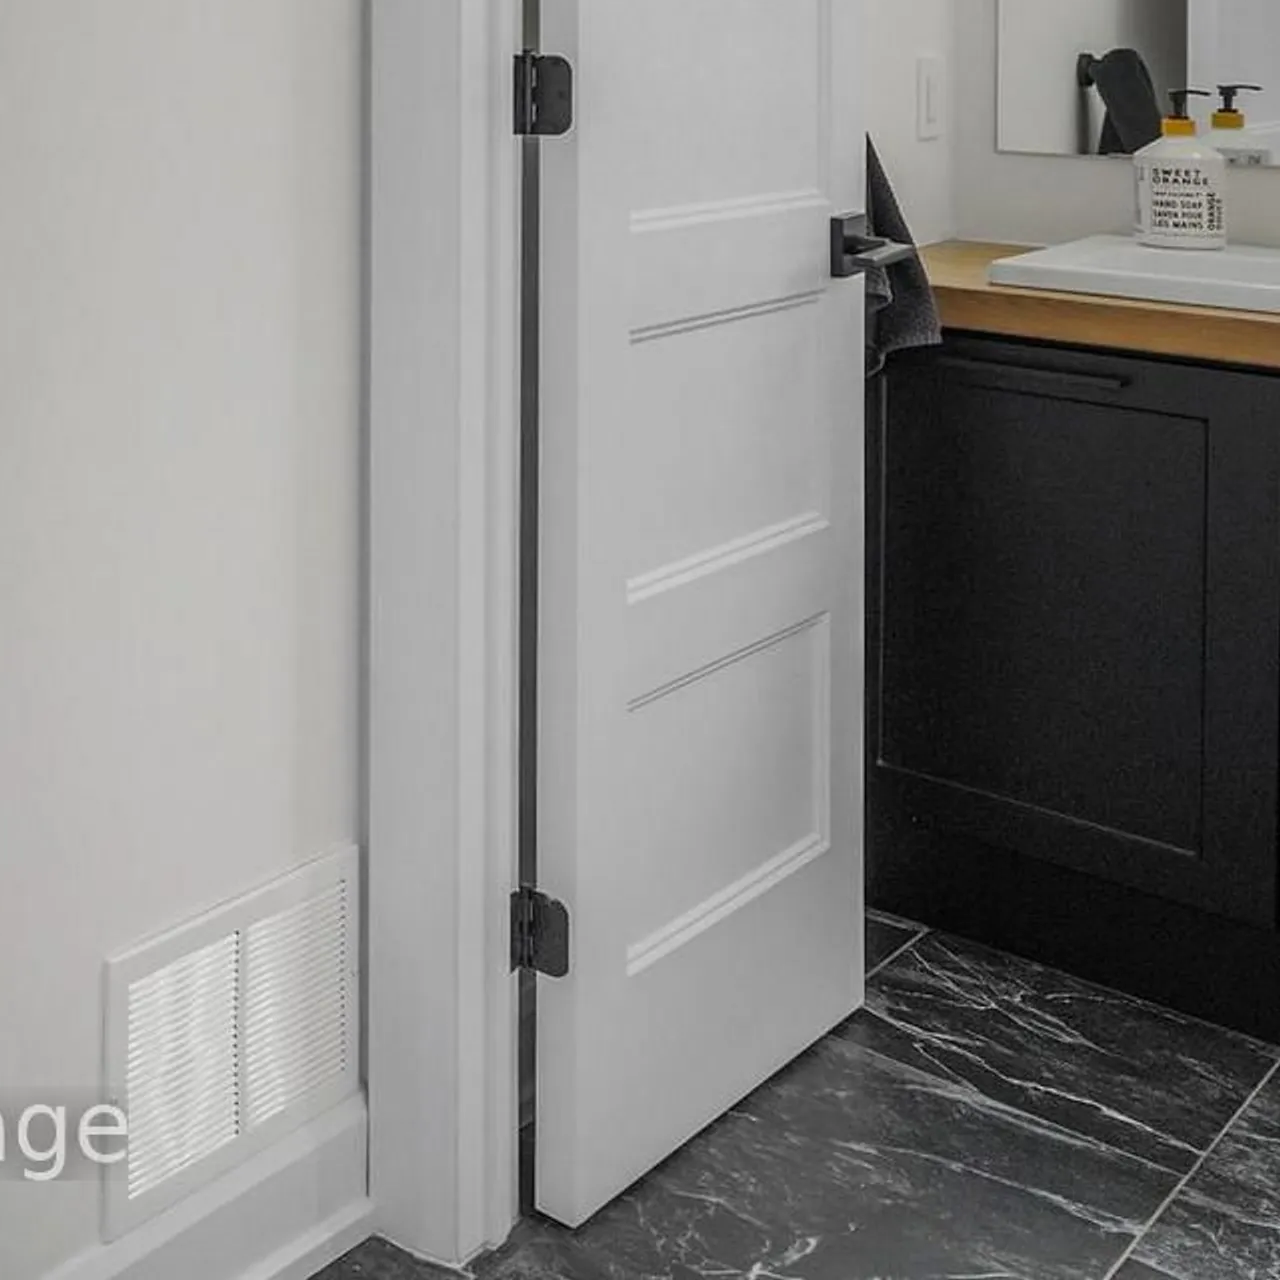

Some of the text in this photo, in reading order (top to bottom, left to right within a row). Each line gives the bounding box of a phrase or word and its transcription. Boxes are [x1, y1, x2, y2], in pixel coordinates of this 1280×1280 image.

[1152, 168, 1201, 177] SWEET
[1152, 176, 1208, 185] ORANGE
[1172, 221, 1203, 230] MAINS
